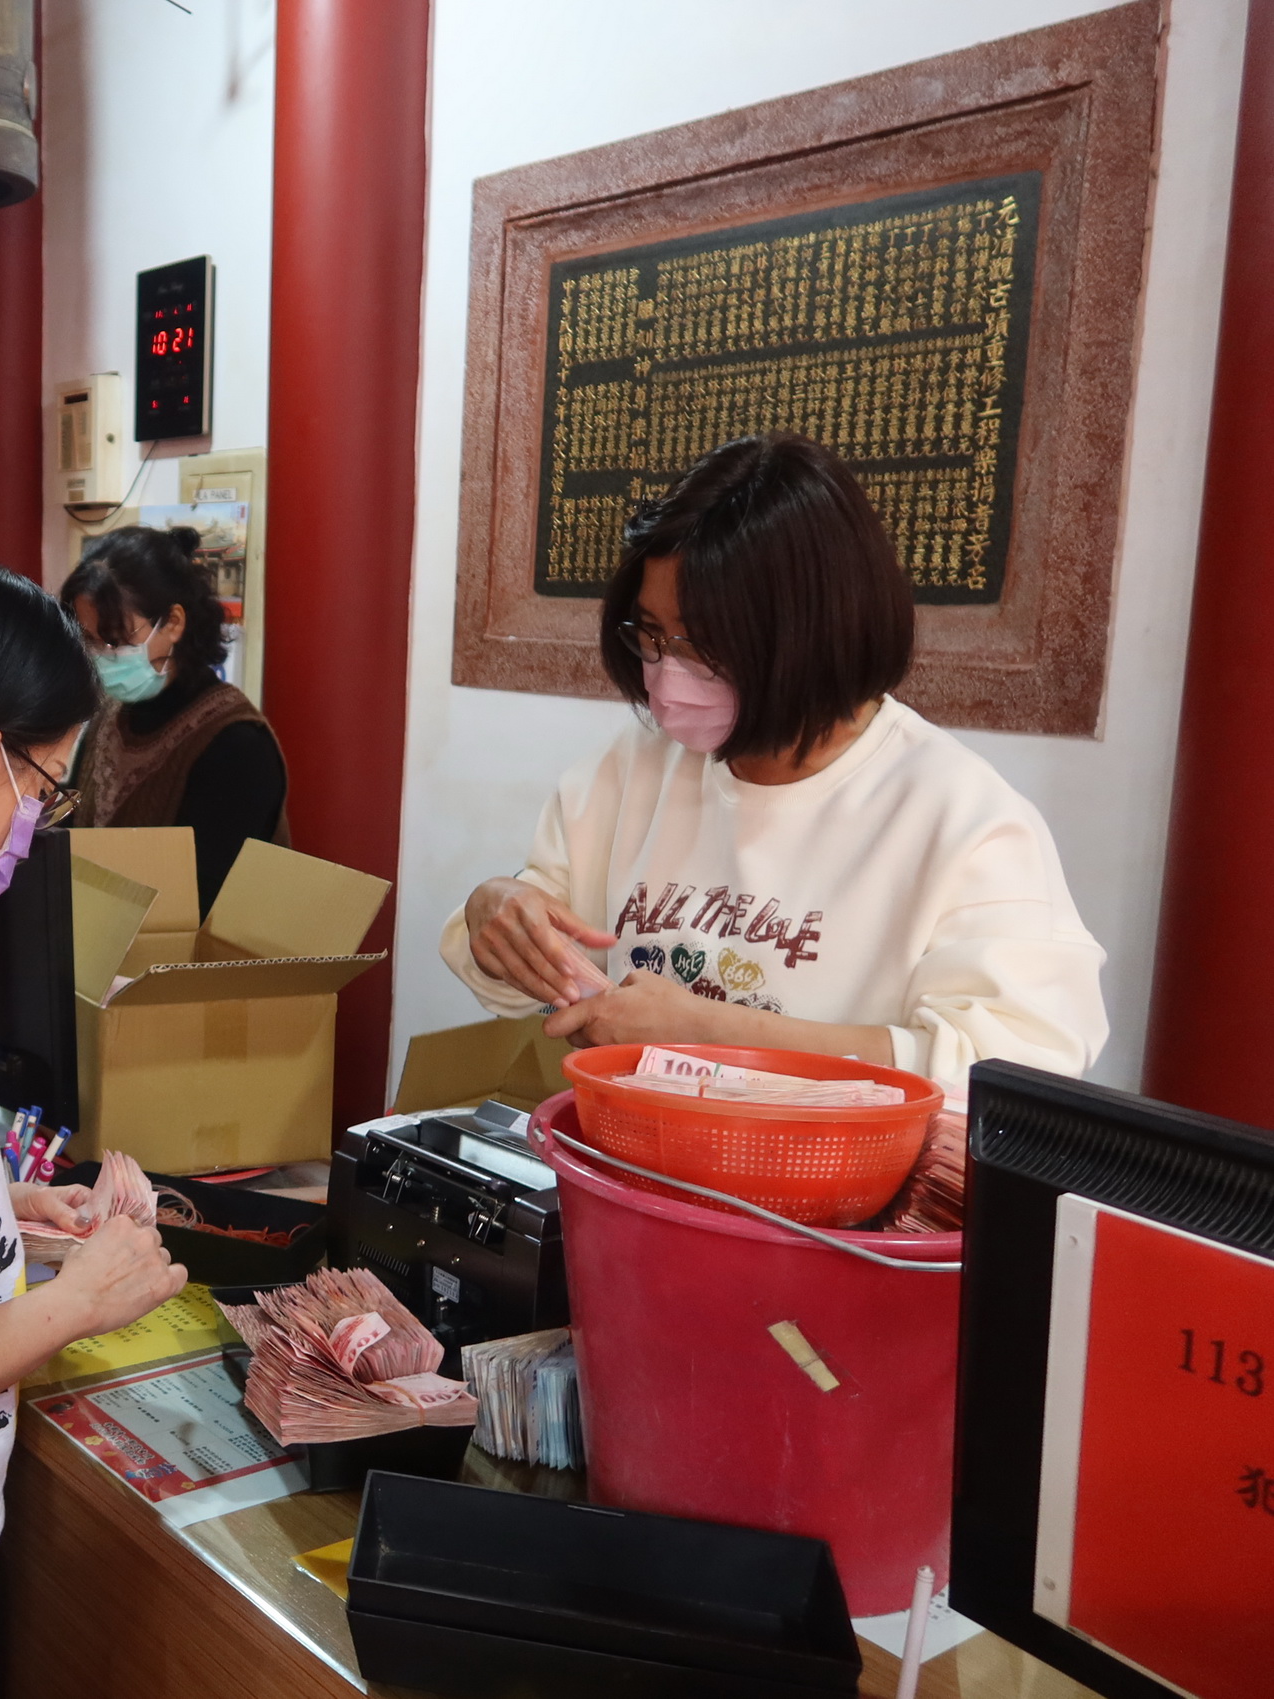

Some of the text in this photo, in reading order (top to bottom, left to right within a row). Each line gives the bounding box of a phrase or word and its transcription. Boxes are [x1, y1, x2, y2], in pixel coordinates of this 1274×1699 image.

[615, 882, 823, 969] ALL THE LOVE
[1180, 1329, 1266, 1397] 113
